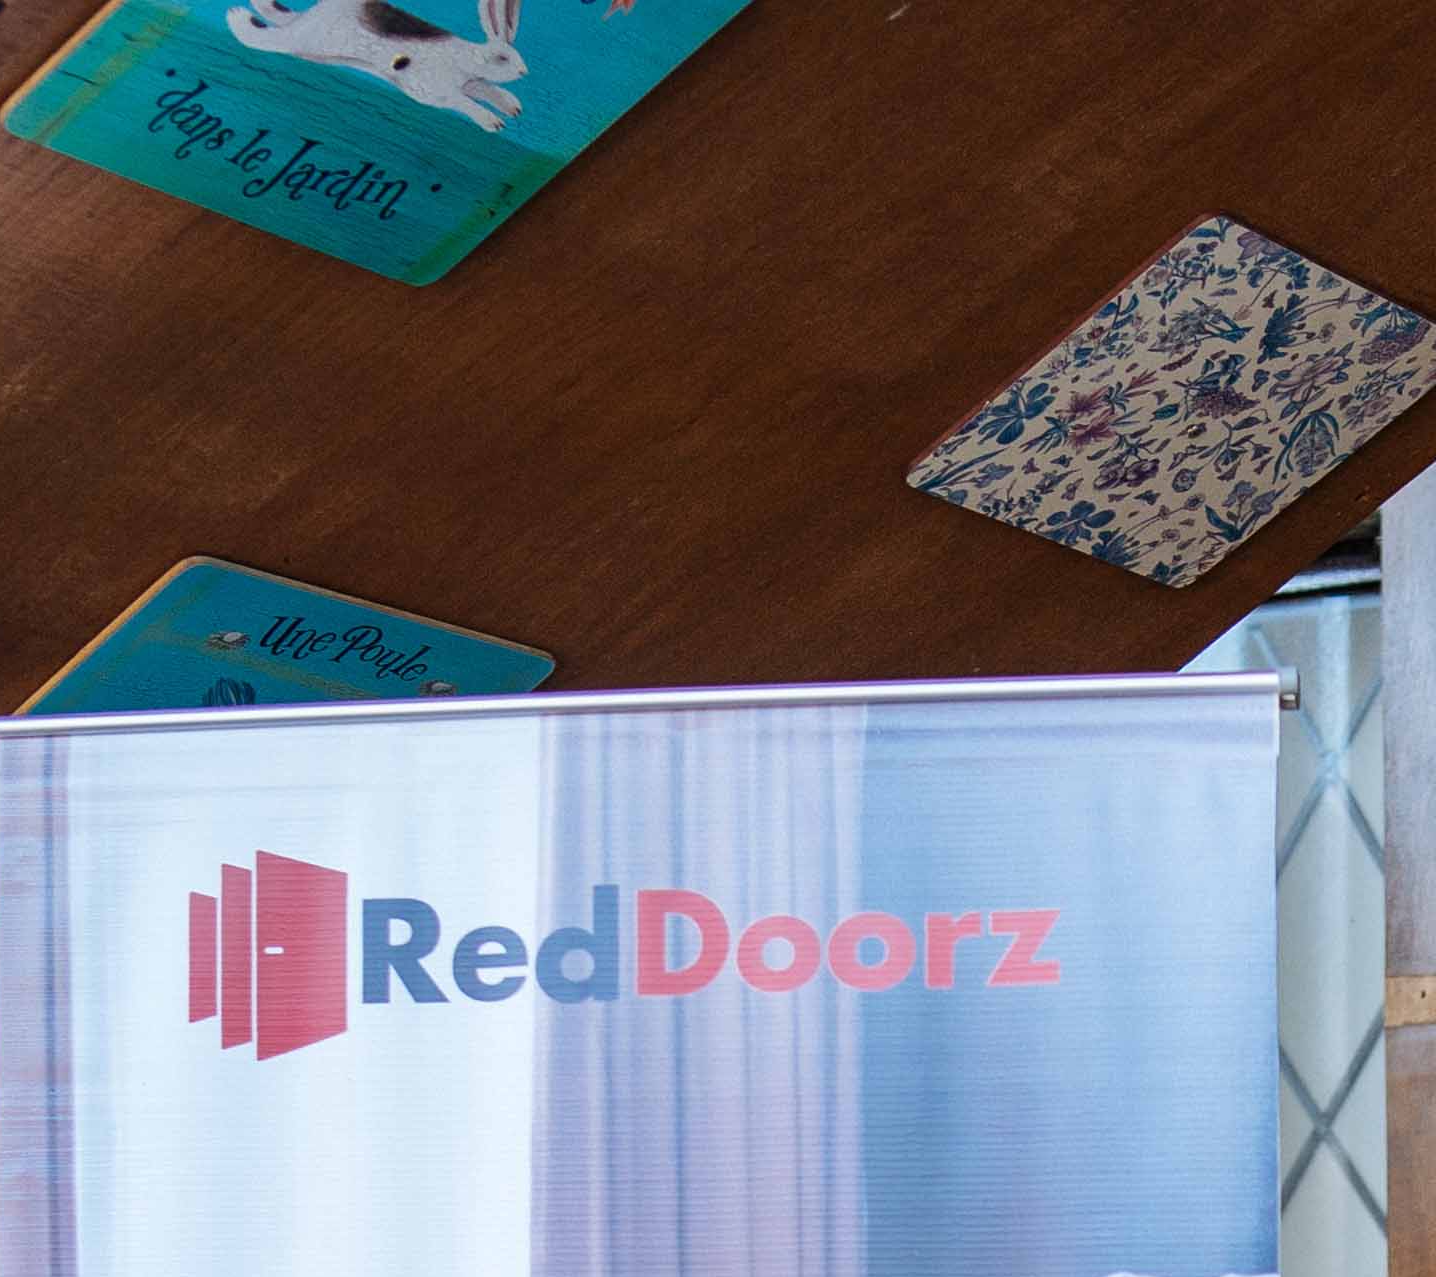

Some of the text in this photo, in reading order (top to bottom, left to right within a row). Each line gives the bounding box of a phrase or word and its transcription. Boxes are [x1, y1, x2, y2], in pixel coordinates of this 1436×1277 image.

[147, 79, 409, 220] dans le Jardin
[259, 615, 433, 682] Une Poule
[361, 883, 1063, 1006] RedDoorz
